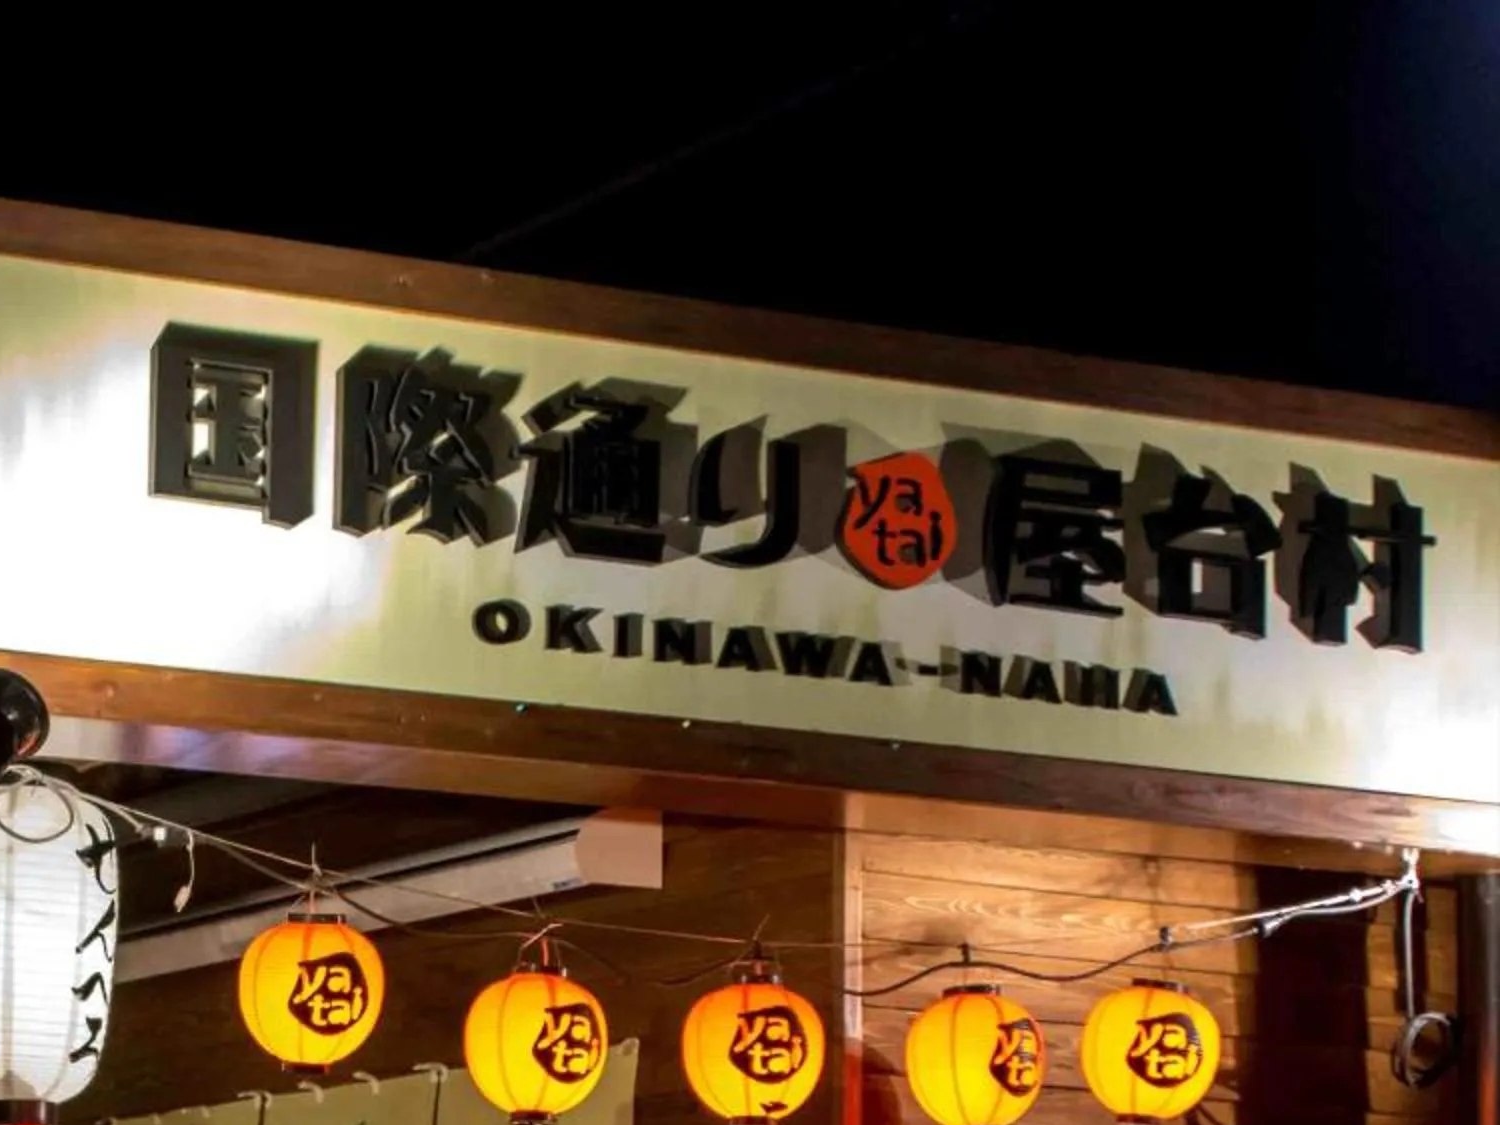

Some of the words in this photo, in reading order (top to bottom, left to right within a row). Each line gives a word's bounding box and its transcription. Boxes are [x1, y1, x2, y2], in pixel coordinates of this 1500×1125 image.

[150, 321, 802, 568] 国際通り
[983, 450, 1436, 653] 屋台村
[852, 464, 924, 530] ya
[872, 512, 946, 570] tai
[296, 963, 353, 1008] ya
[537, 1006, 591, 1050] ya
[736, 1012, 790, 1054] ya
